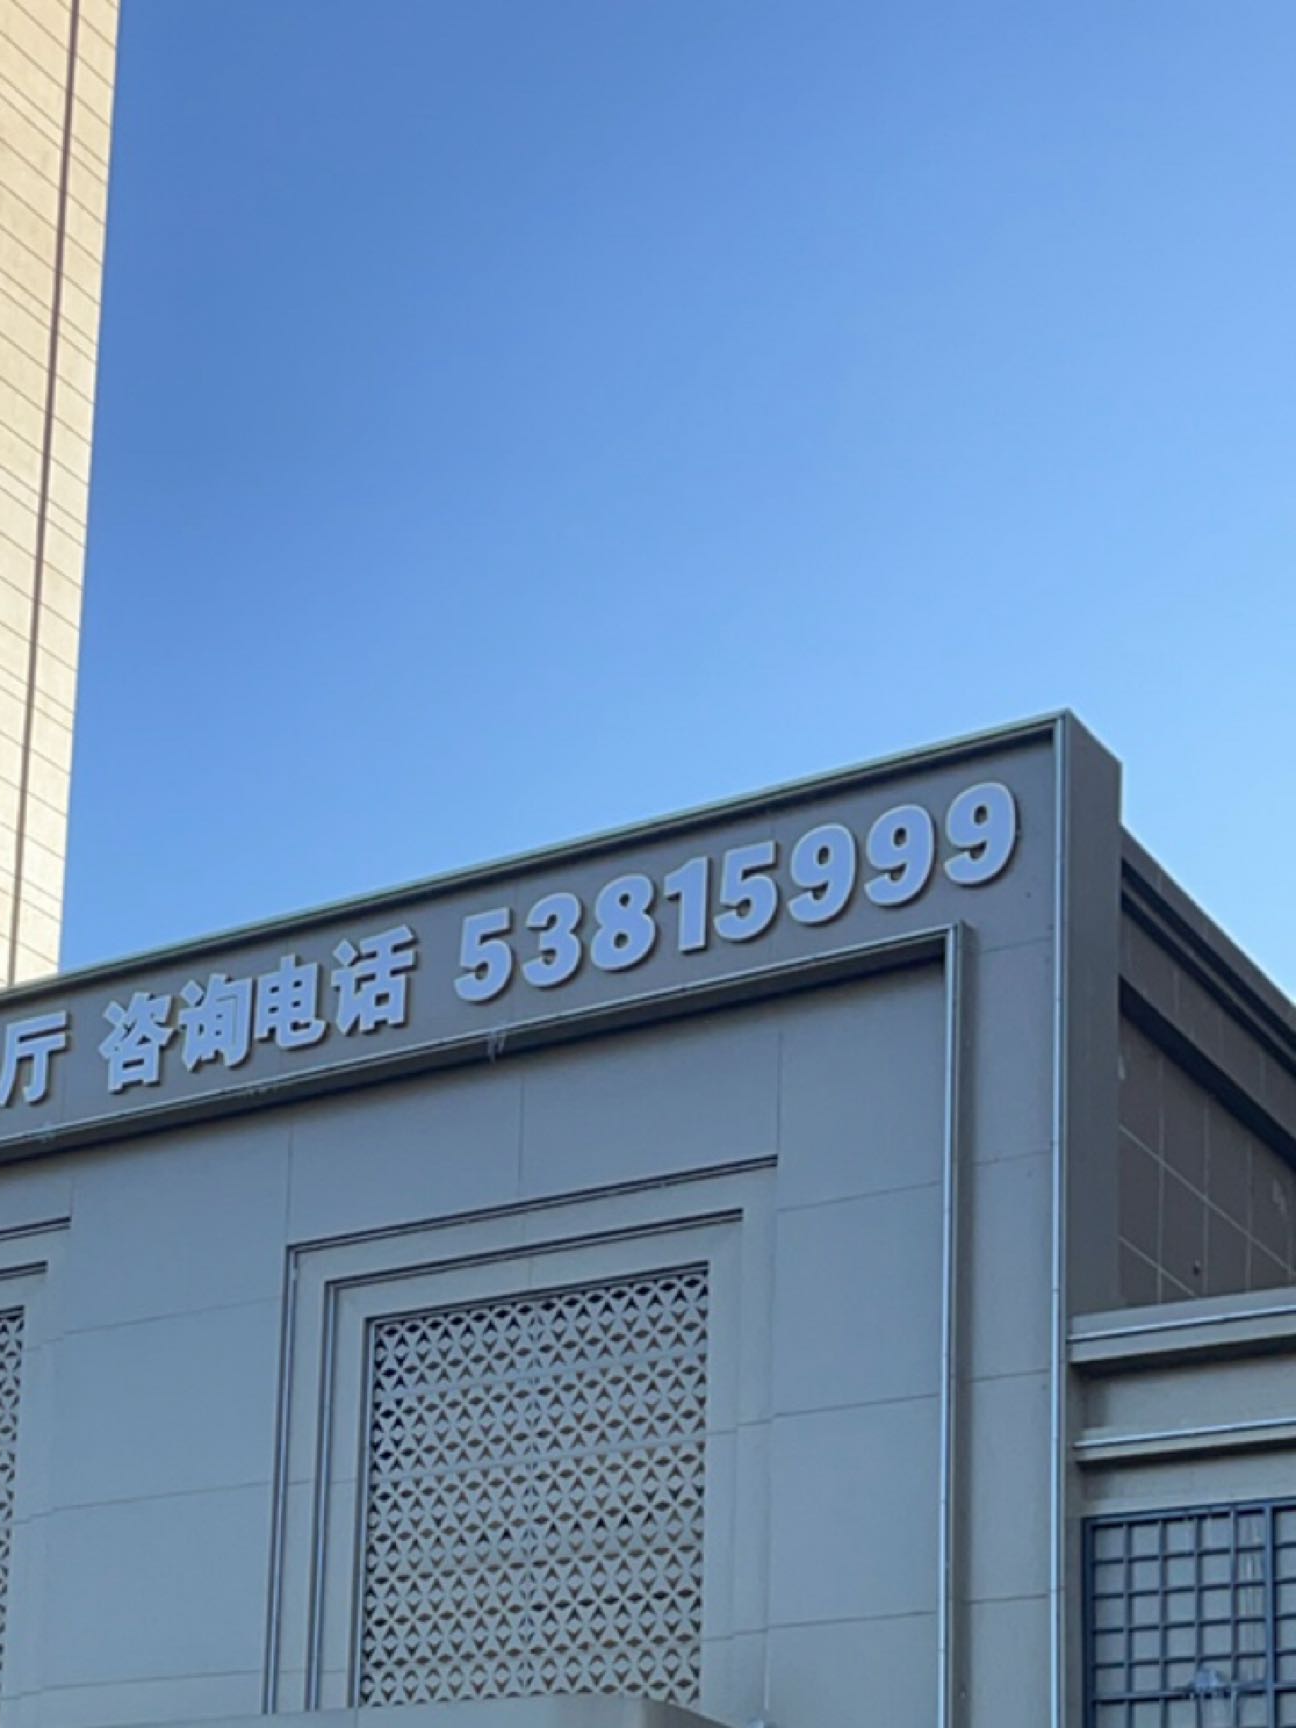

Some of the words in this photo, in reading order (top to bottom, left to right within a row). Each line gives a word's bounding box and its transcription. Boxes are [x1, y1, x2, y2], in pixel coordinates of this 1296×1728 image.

[98, 925, 417, 1092] 咨询电话
[454, 782, 1019, 1003] 53815999
